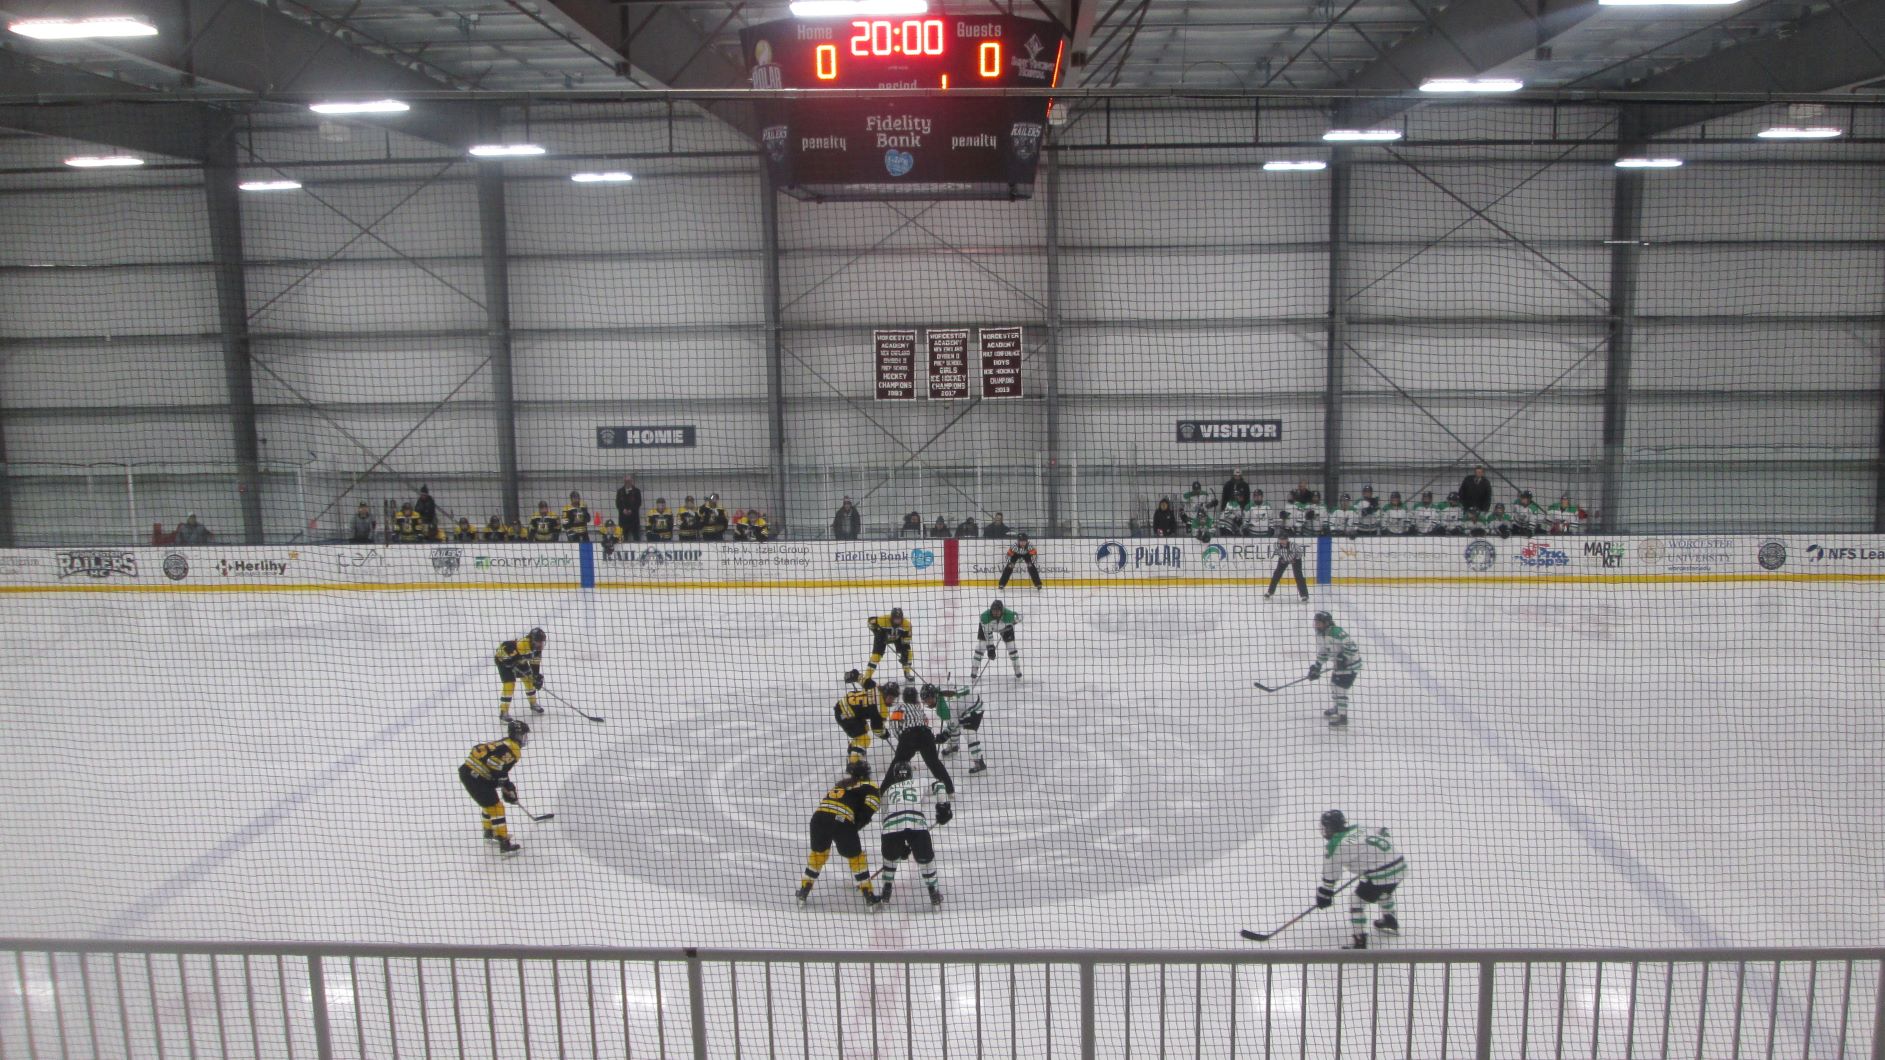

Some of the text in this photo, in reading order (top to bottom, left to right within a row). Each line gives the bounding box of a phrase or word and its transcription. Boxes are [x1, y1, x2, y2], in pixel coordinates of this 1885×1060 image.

[797, 24, 832, 39] Home
[957, 22, 1002, 38] Guests
[851, 20, 943, 56] 20:00
[816, 44, 837, 79] 0
[980, 43, 1000, 77] 0
[941, 73, 948, 89] 1
[866, 115, 932, 134] Fidelity
[1011, 125, 1042, 138] RAILERS
[801, 134, 847, 151] penalty
[876, 133, 921, 148] Bank
[951, 133, 997, 150] penalty
[931, 382, 966, 390] CHAMPIONS
[626, 430, 684, 445] HOME
[1199, 424, 1277, 438] VISITOR
[722, 545, 740, 555] The
[779, 545, 811, 556] Group
[1584, 542, 1611, 556] MAR
[1668, 540, 1733, 548] WORCESTER
[431, 549, 462, 558] RAILERS
[664, 550, 702, 561] SHOP
[834, 551, 877, 563] Fidelity
[880, 552, 909, 561] Bank
[1232, 545, 1310, 560] RELIAT
[1668, 553, 1730, 562] UNIVERSITY
[1828, 548, 1857, 560] NFS
[57, 552, 138, 579] RAILERS
[235, 560, 286, 575] Herlihy
[490, 554, 572, 568] countrybank
[733, 557, 770, 568] Morgan
[773, 557, 811, 567] Stanley
[1602, 555, 1623, 568] KET
